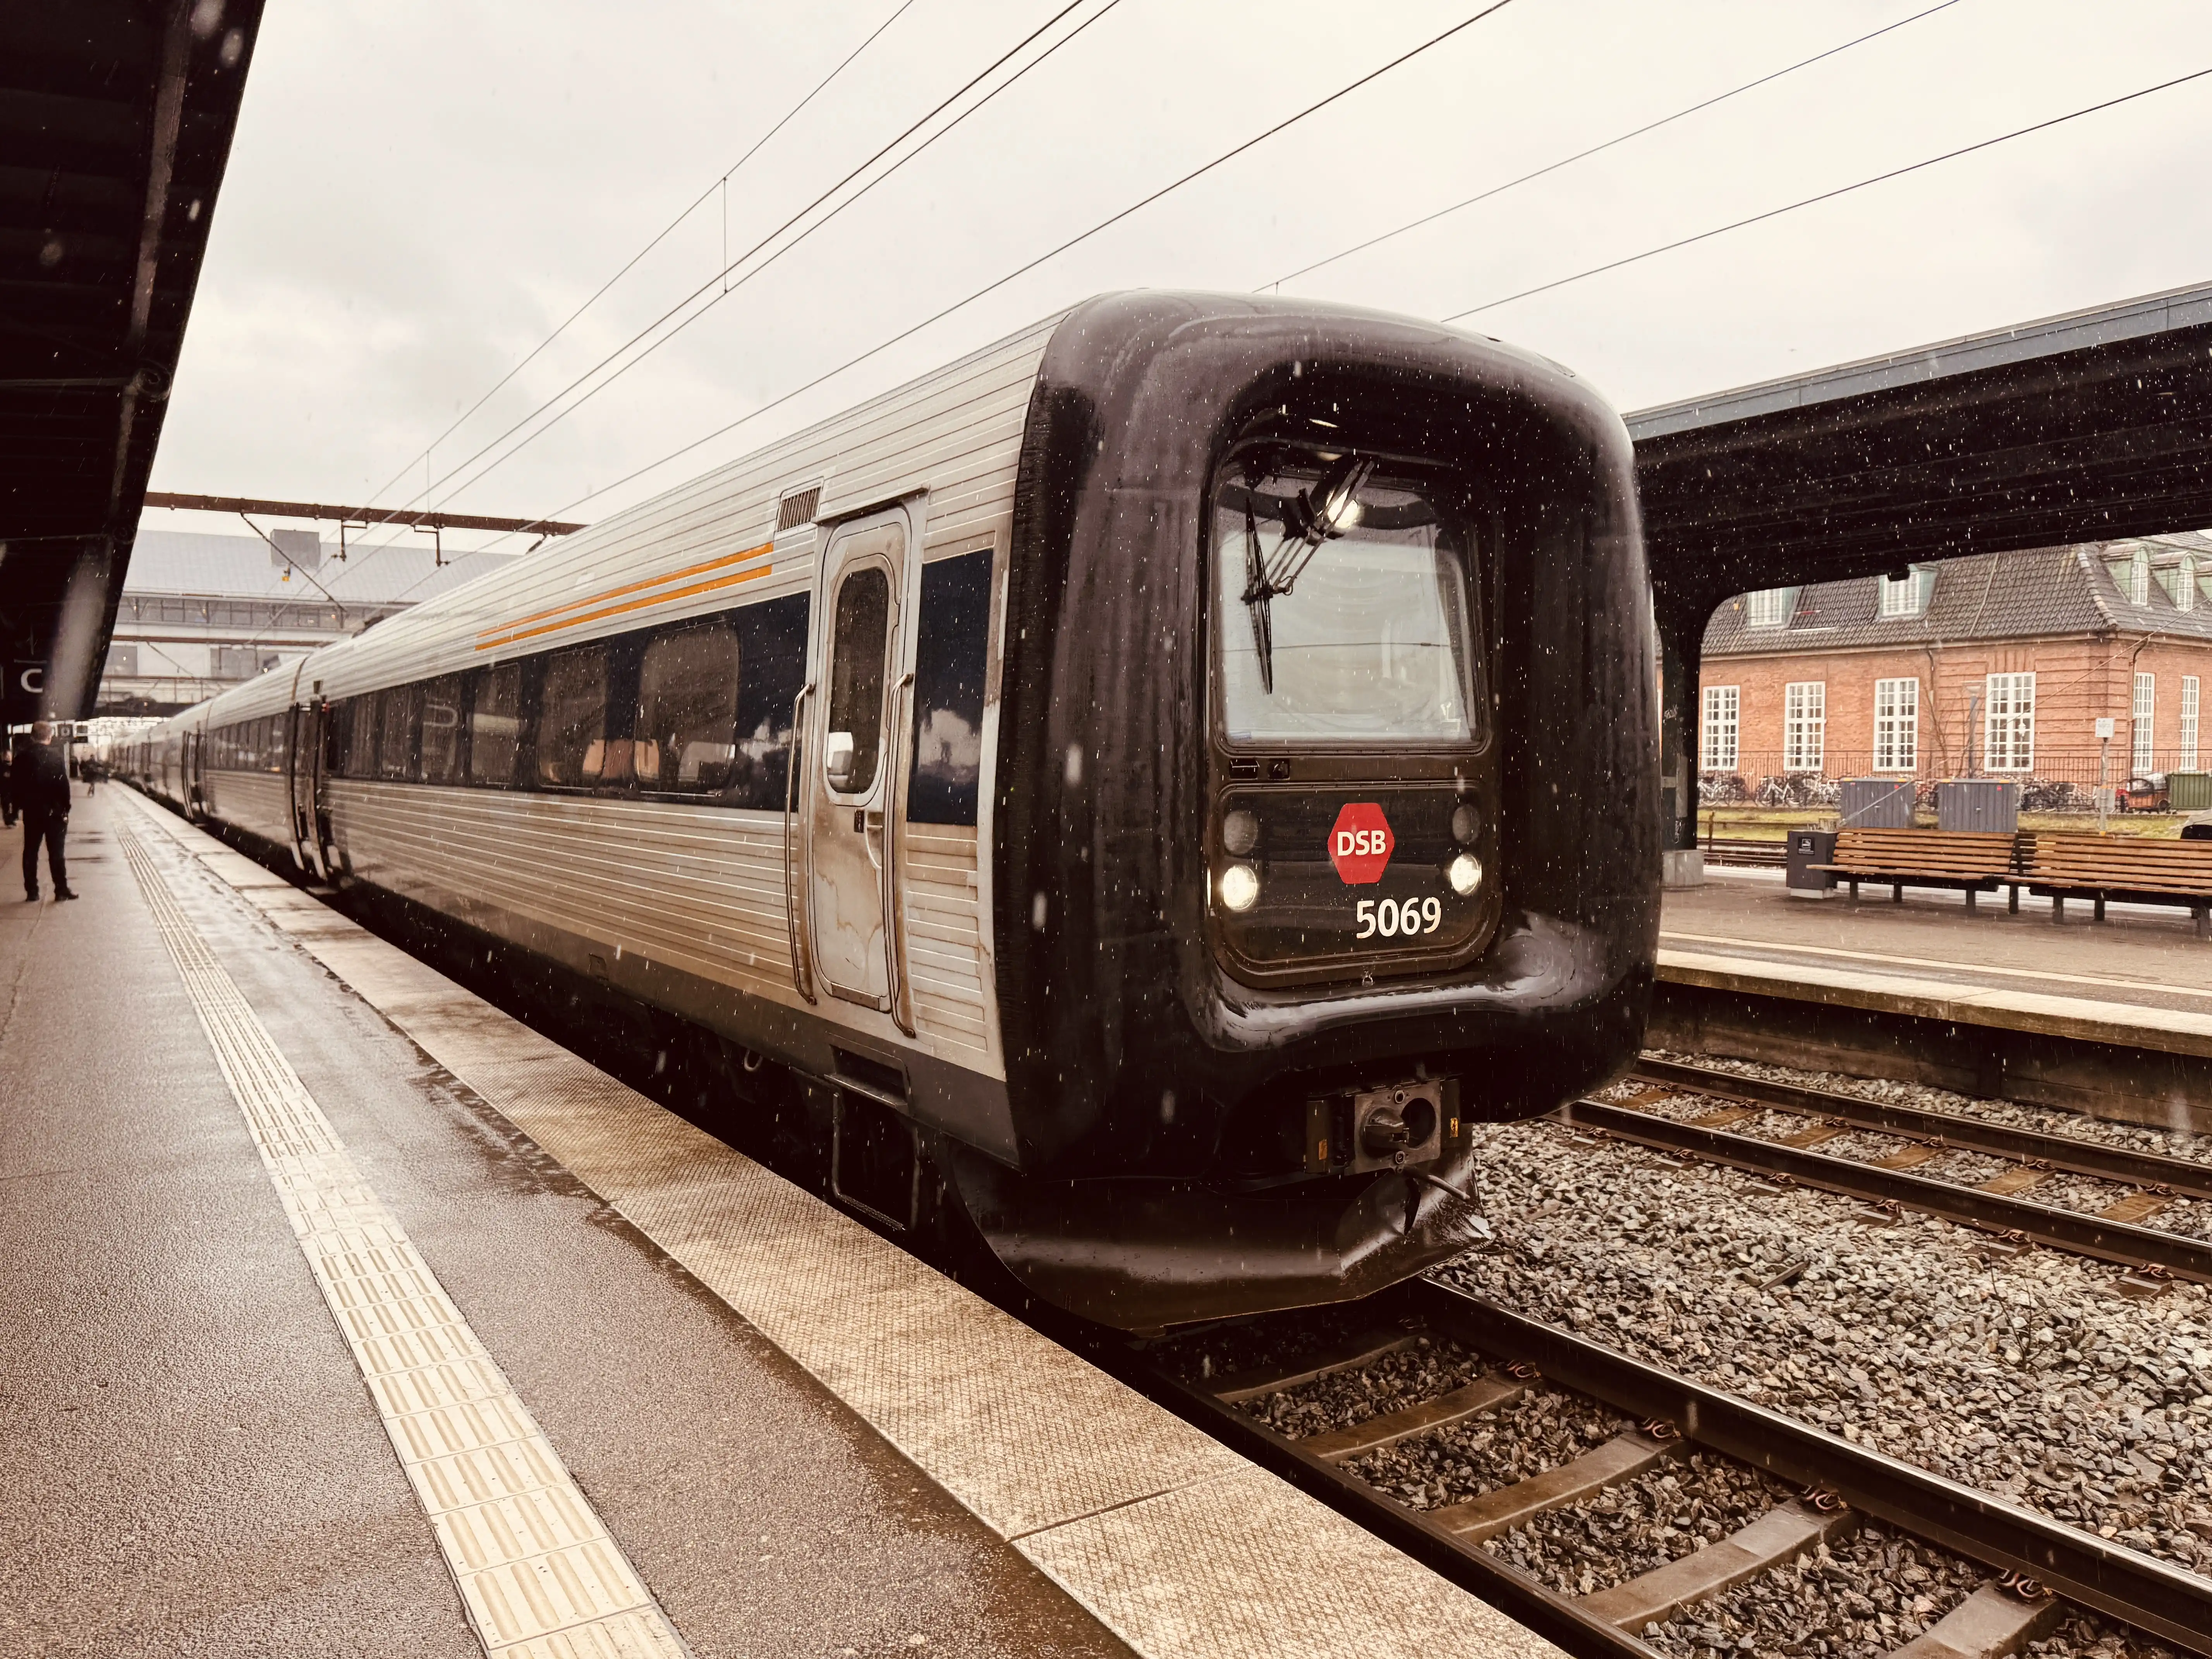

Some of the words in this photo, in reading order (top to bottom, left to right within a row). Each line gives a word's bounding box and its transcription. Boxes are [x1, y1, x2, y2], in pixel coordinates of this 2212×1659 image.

[21, 668, 43, 693] C
[1337, 830, 1386, 857] DSB
[1356, 896, 1441, 939] 5069
